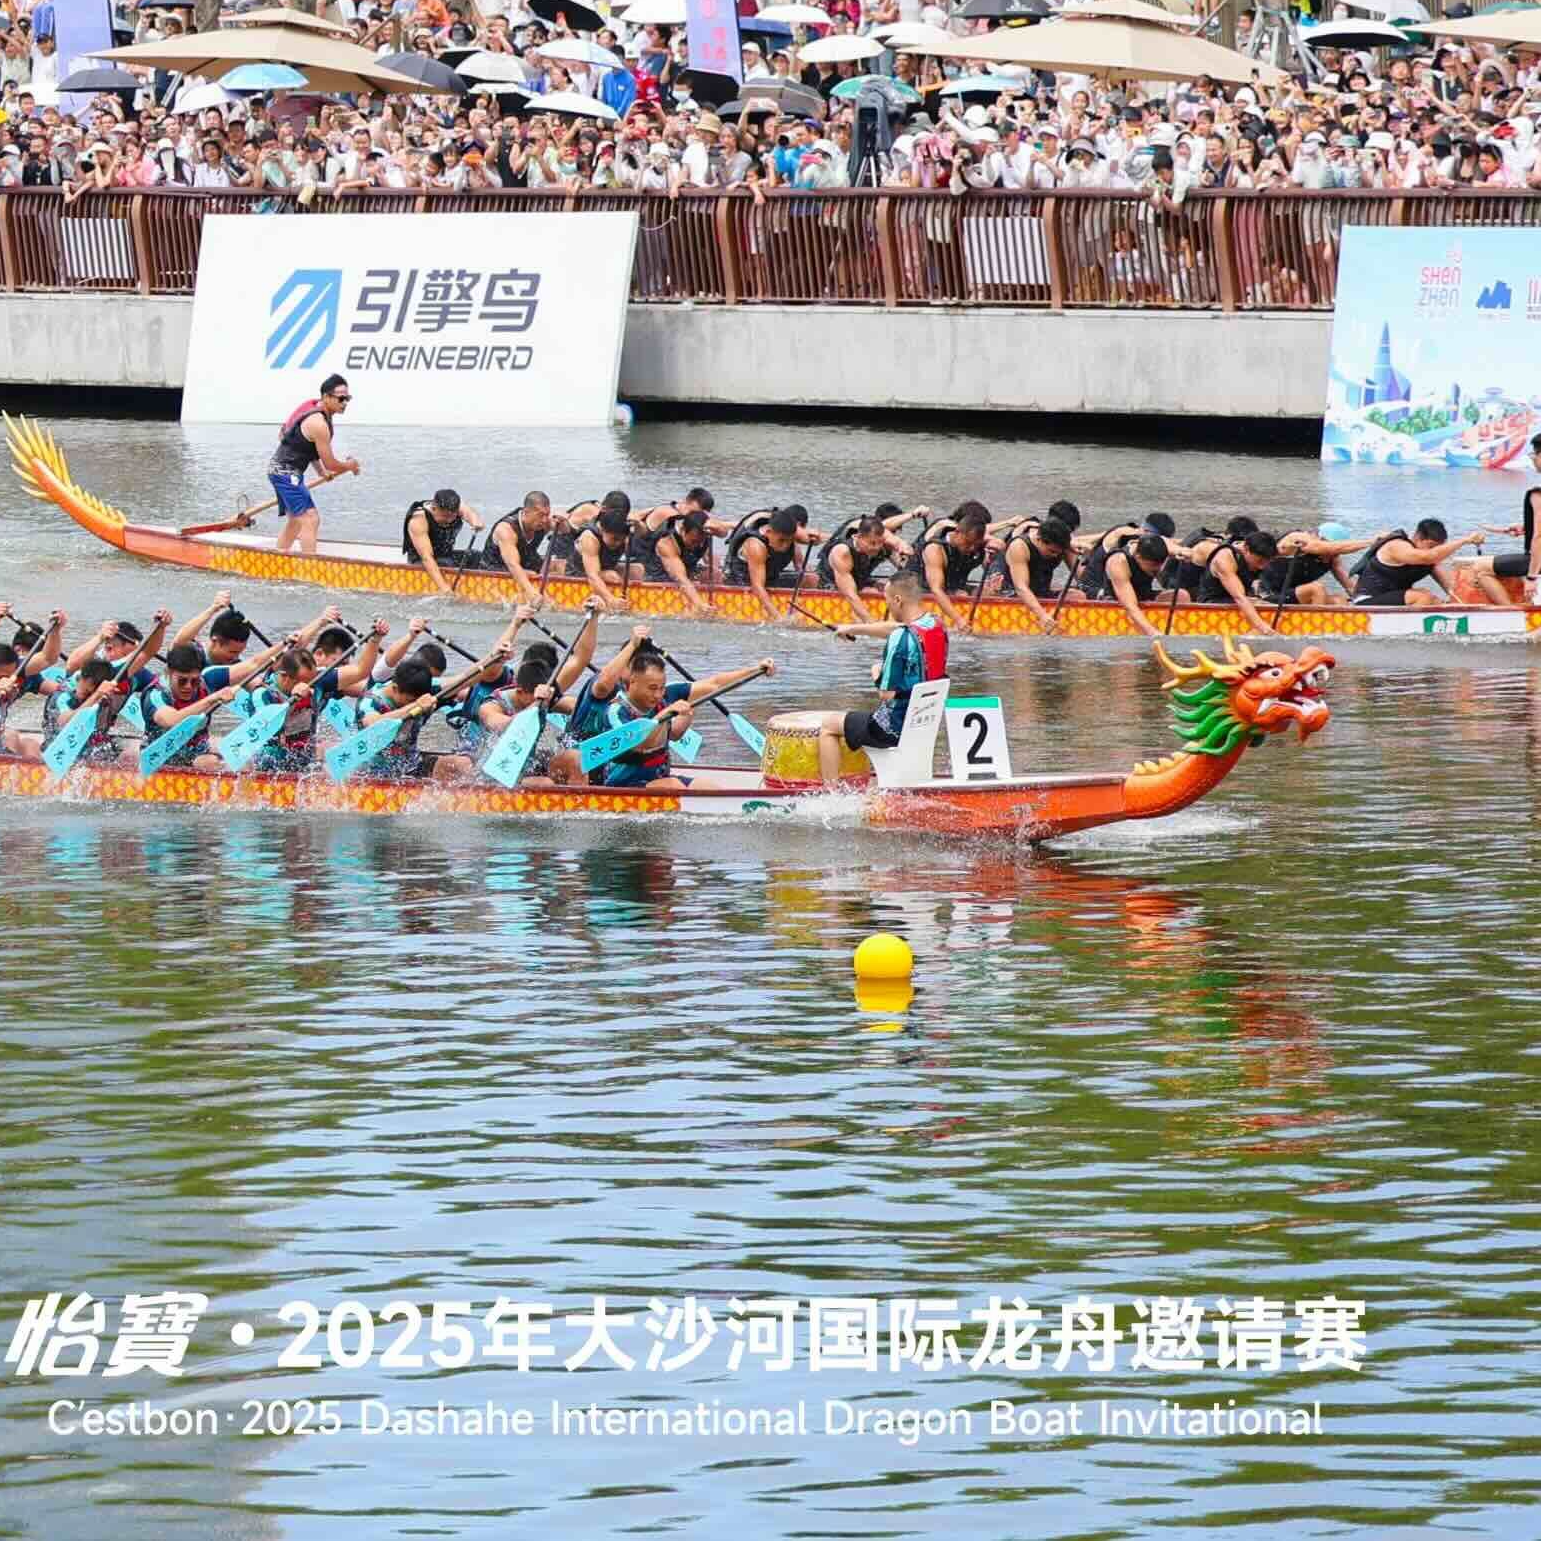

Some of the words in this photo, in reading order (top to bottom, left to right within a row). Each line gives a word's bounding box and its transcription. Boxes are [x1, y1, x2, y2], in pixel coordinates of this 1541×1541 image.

[350, 267, 542, 334] 引擎鸟
[345, 345, 534, 372] ENGINEBIRD
[963, 711, 993, 765] 2
